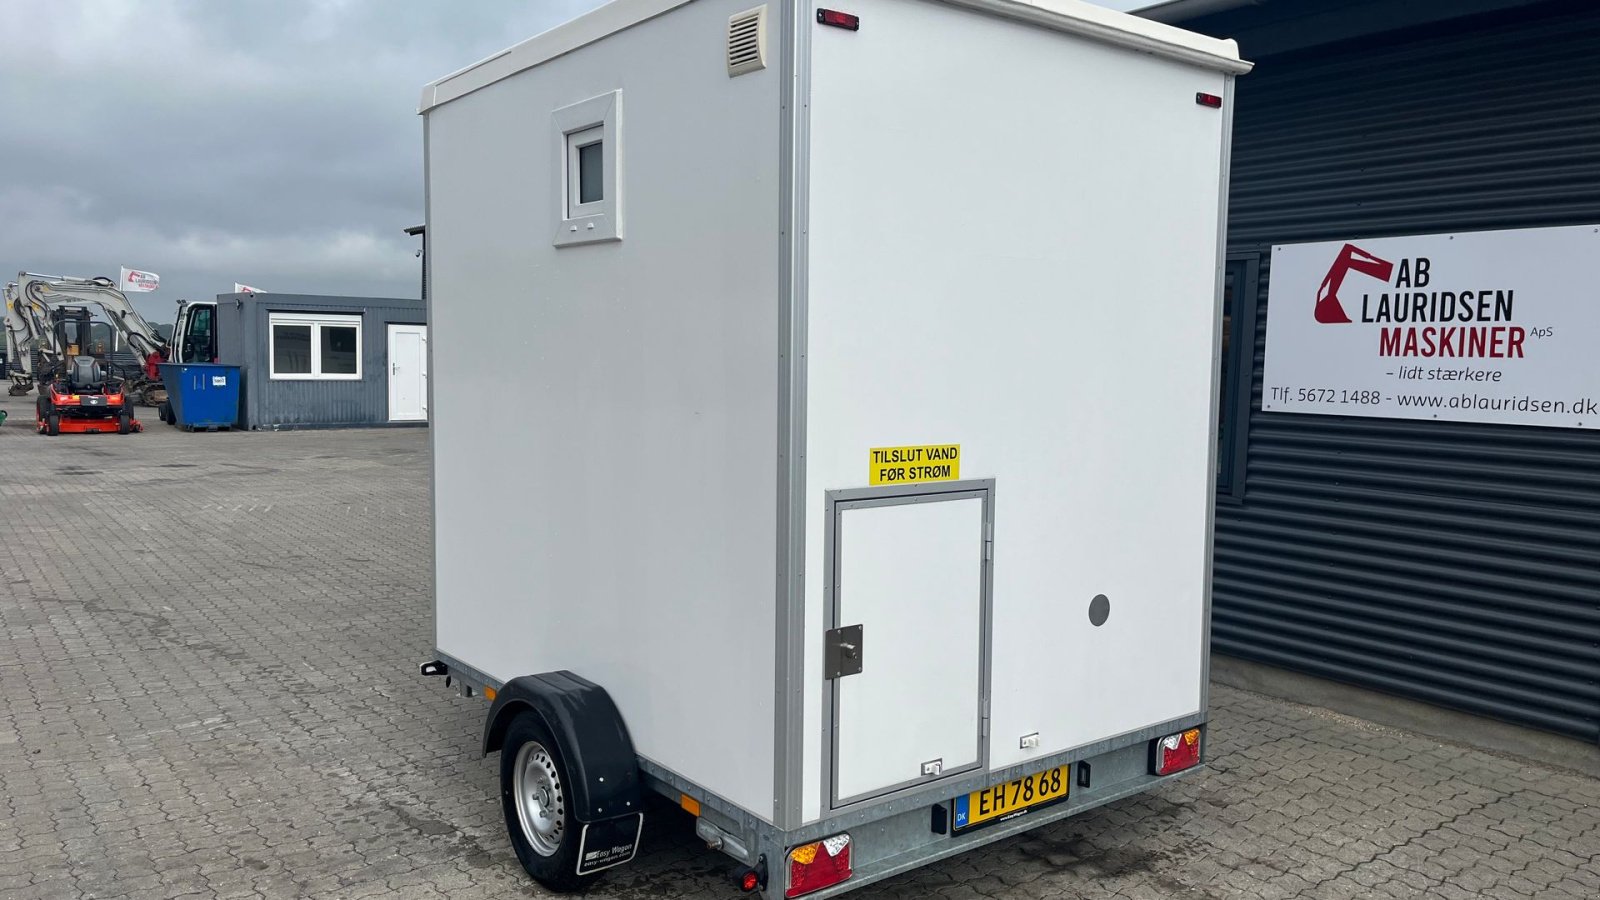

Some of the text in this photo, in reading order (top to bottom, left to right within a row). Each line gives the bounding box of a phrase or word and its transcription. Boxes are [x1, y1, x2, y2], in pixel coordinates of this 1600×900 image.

[1395, 258, 1431, 288] AB
[1361, 290, 1514, 323] LAURIDSEN
[1378, 326, 1553, 358] MASKINER ApS
[1398, 366, 1424, 380] lidt
[1427, 367, 1502, 382] stærkere
[1271, 387, 1293, 404] Tlf.
[1298, 388, 1336, 403] 5672
[1340, 390, 1381, 405] 1488
[1397, 394, 1598, 416] www.ablauridsen.dk
[873, 447, 958, 464] TILSLUT VAND
[880, 465, 951, 481] FØR STRØM
[979, 768, 1061, 815] EH 78 68
[957, 812, 966, 822] DK
